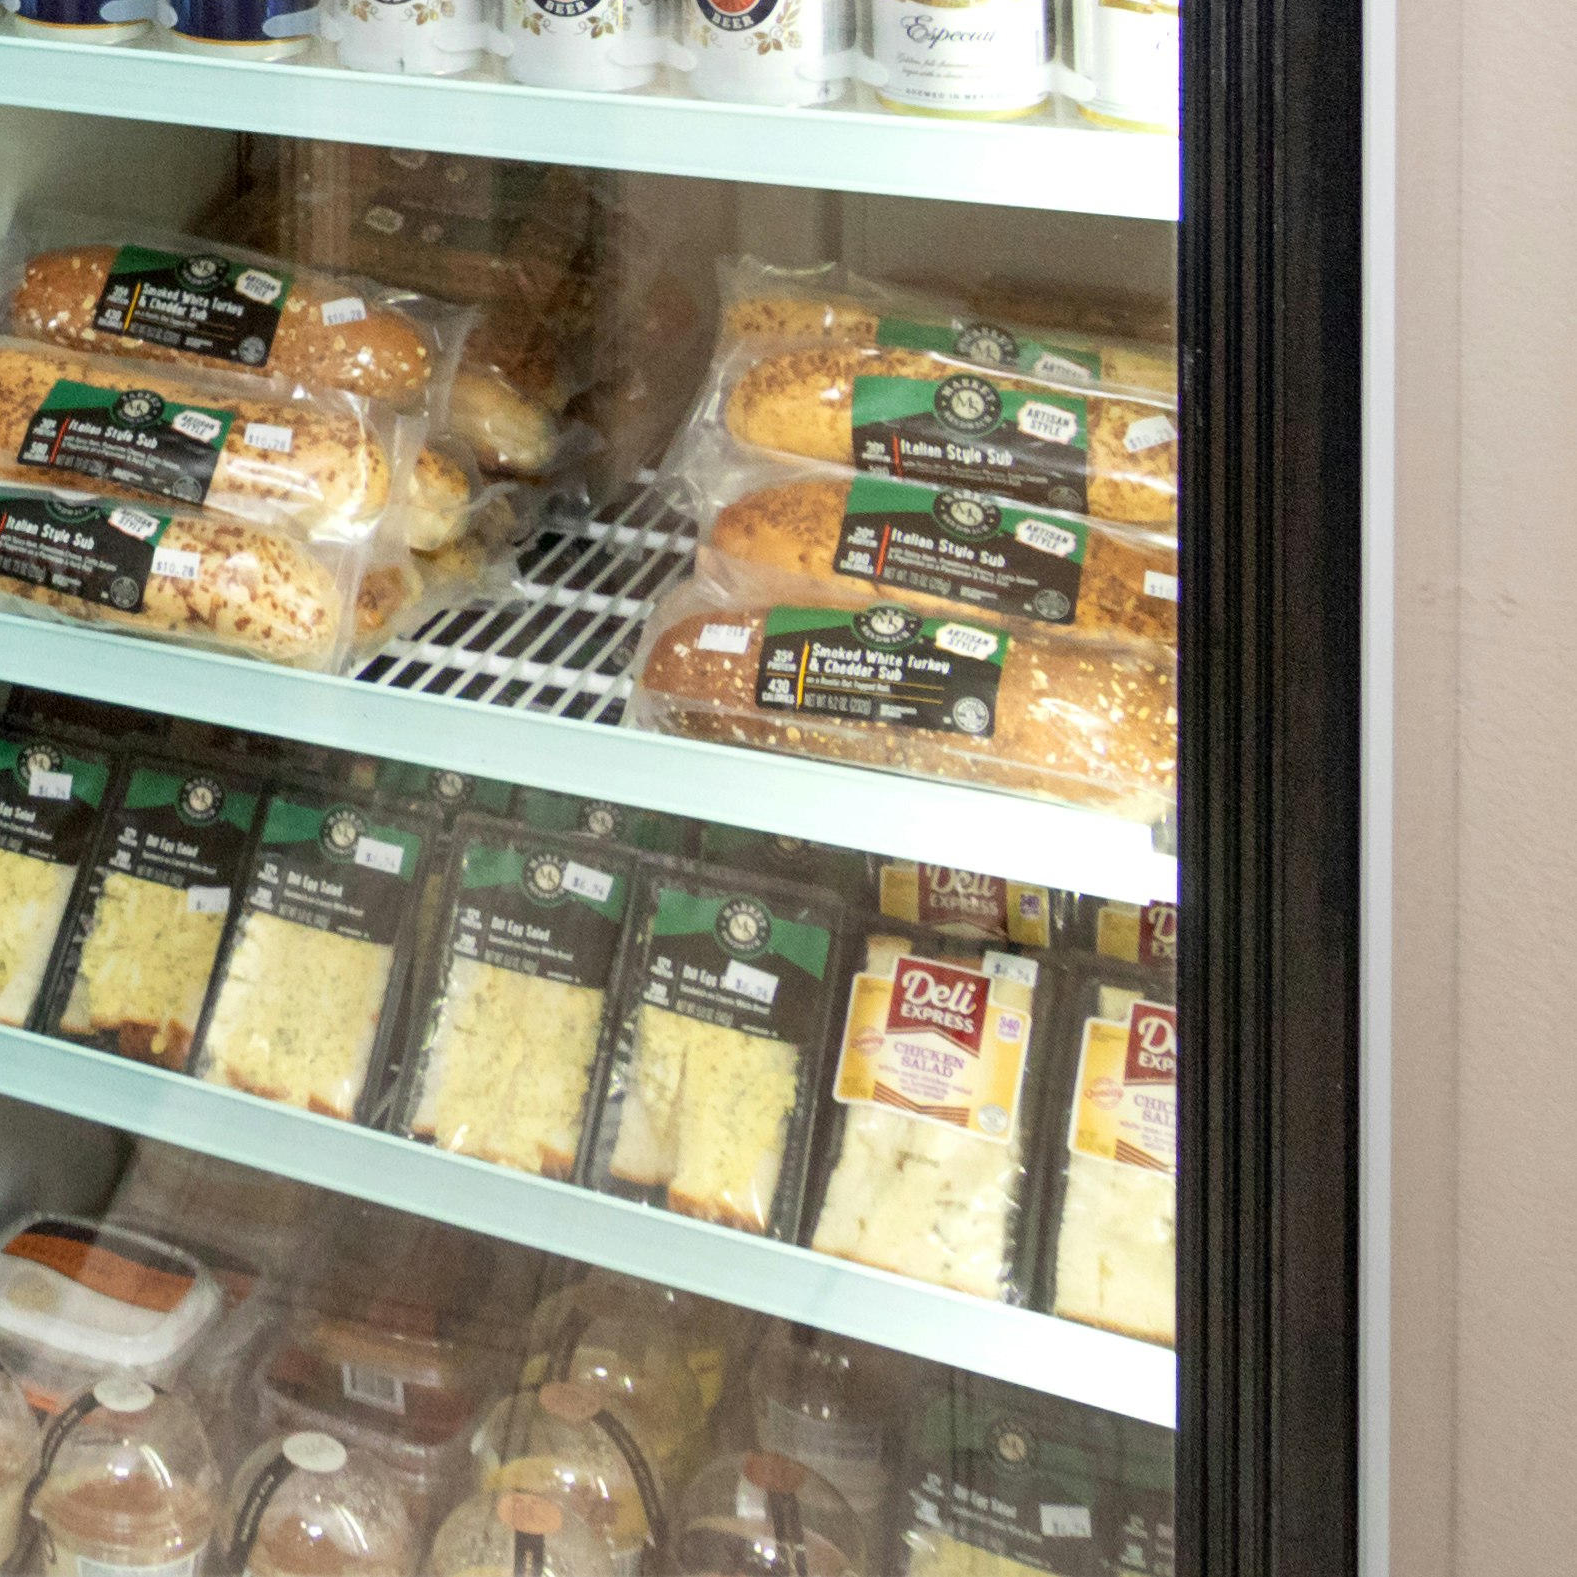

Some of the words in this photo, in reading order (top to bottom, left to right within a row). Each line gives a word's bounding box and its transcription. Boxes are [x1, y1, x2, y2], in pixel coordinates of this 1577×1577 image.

[545, 0, 588, 16] BEER
[711, 14, 755, 29] BEER
[189, 304, 209, 321] Sub
[1025, 407, 1070, 429] ARTISAN
[1028, 417, 1063, 438] STYLE
[69, 419, 102, 436] Italian
[104, 426, 134, 443] Style
[136, 433, 158, 450] Sub
[900, 439, 943, 458] Italian
[946, 443, 982, 464] Style
[986, 447, 1014, 467] Sub
[6, 515, 40, 536] Italian
[41, 523, 71, 545] Style
[73, 532, 96, 551] Sub
[1024, 522, 1070, 545] ARTISAN
[891, 527, 935, 550] Italian
[938, 538, 975, 561] Style
[978, 546, 1007, 568] Sub
[156, 560, 195, 576] $10.28
[946, 627, 991, 648] ARTISAN
[946, 636, 979, 653] STYLE
[808, 657, 820, 673] &
[824, 659, 876, 679] Cheddar
[878, 665, 903, 682] Sub
[812, 642, 862, 662] Smoked
[864, 648, 904, 668] White
[906, 654, 951, 674] Turkey
[767, 678, 791, 695] 430
[901, 969, 977, 1016] Deli
[900, 1003, 976, 1034] EXPRESS
[893, 1041, 966, 1069] CHICKEN
[901, 1055, 955, 1079] SALAD
[1133, 1093, 1178, 1116] CHIC
[1142, 1107, 1178, 1126] SAL
